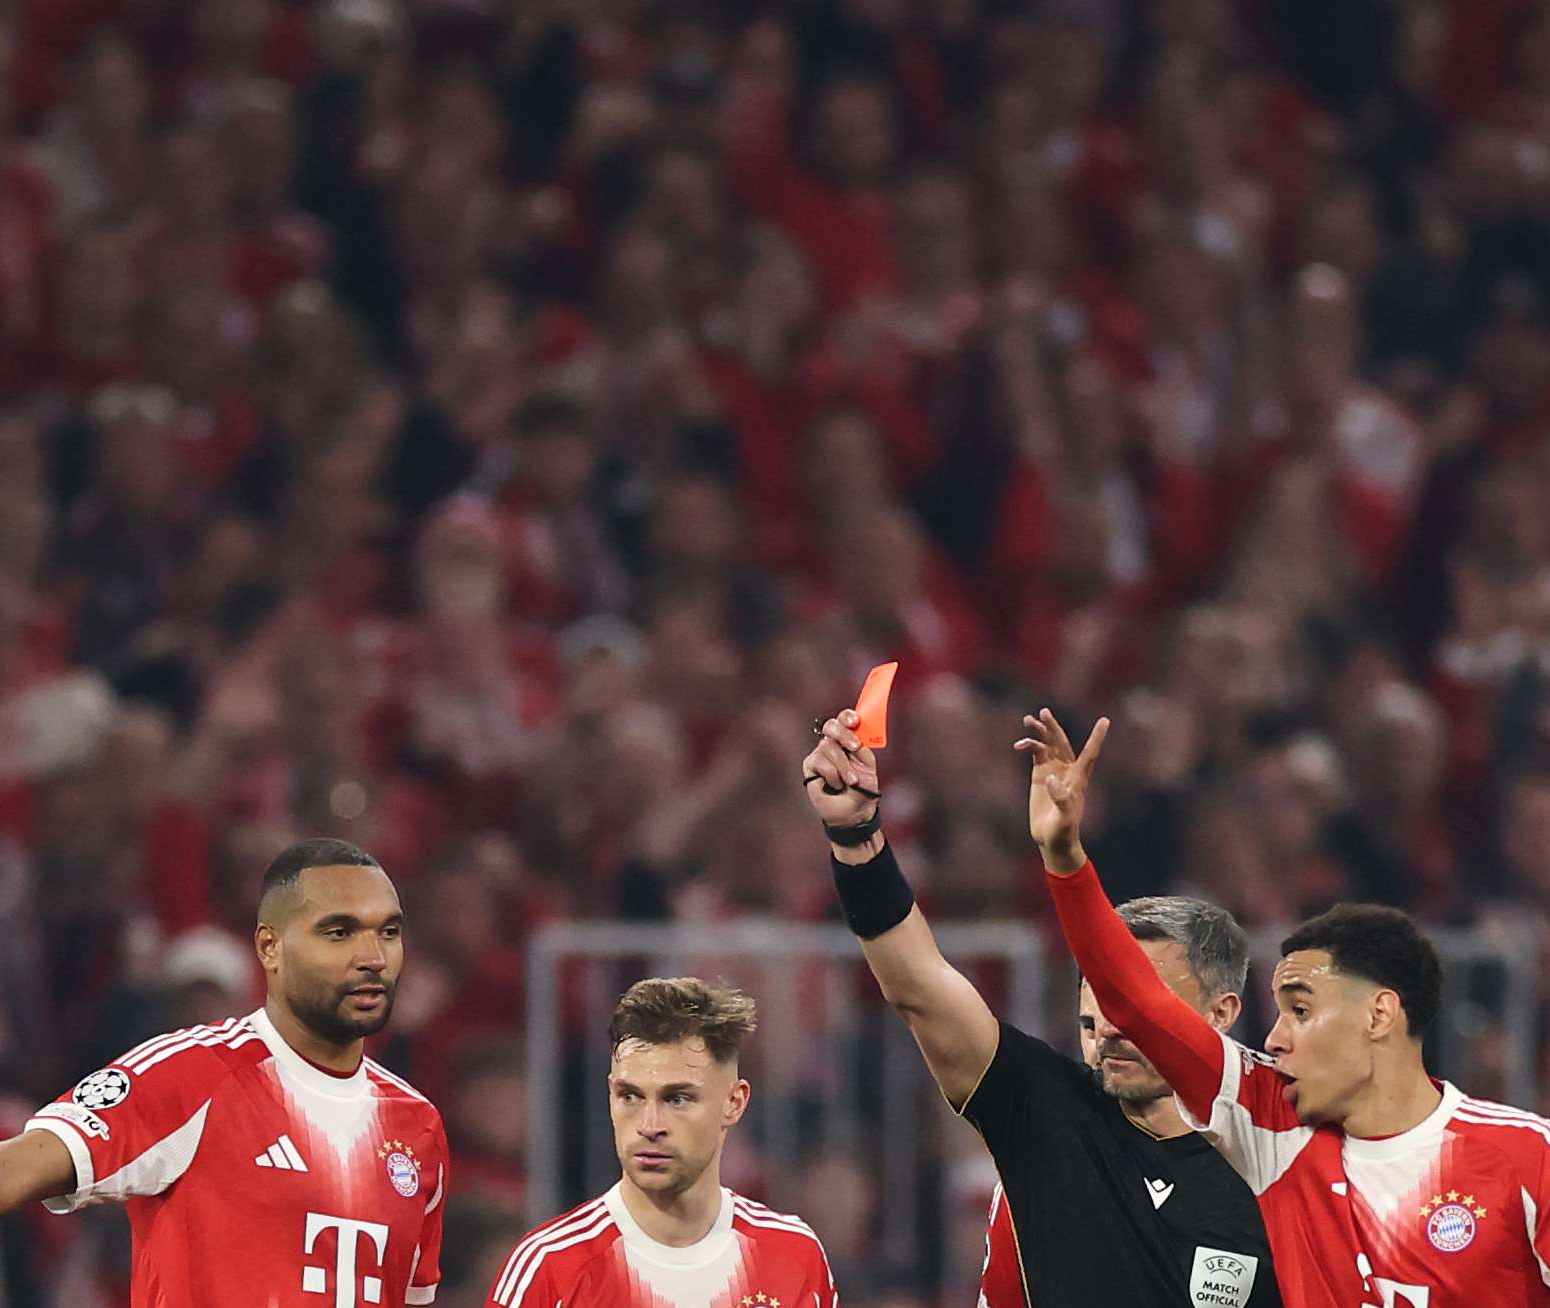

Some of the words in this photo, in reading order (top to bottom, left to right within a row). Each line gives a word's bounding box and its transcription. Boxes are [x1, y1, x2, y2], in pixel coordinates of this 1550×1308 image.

[1206, 1258, 1243, 1276] UEFA
[1202, 1280, 1240, 1295] MATCH
[1196, 1291, 1240, 1308] OFFICIAL
